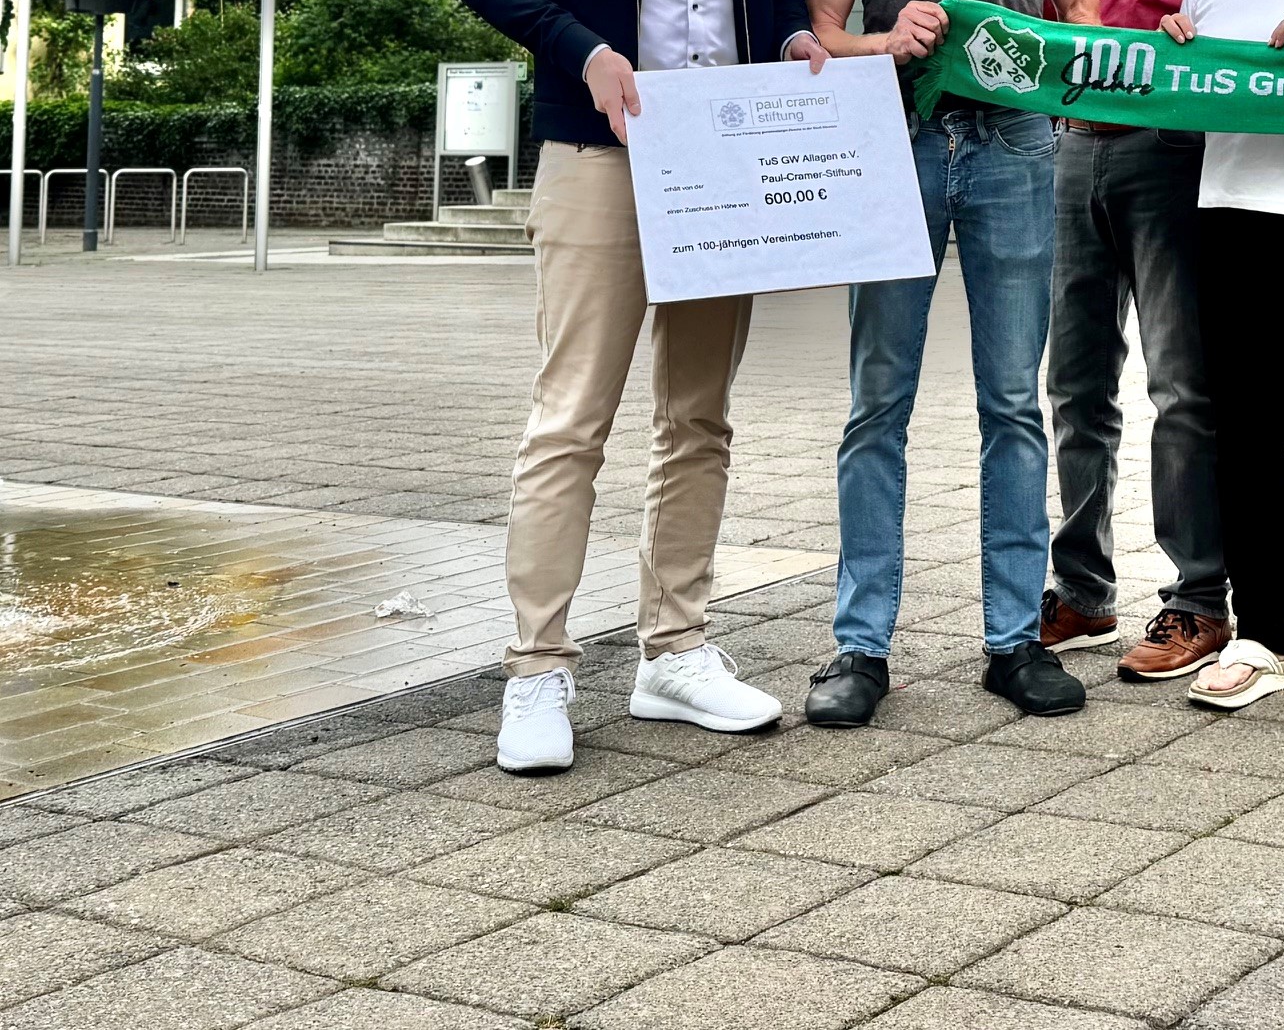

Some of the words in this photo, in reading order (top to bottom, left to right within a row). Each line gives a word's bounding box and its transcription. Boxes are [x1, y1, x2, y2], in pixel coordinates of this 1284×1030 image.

[982, 36, 997, 53] 19
[1007, 67, 1026, 84] 26
[1002, 38, 1031, 67] TuS
[1072, 36, 1156, 92] 100
[1165, 64, 1238, 94] TuS
[756, 98, 782, 112] paul
[786, 96, 830, 108] cramer
[758, 111, 804, 123] stiftung
[758, 157, 779, 166] TuS
[781, 154, 800, 164] GW
[802, 152, 838, 163] Allagen
[840, 150, 860, 160] e.V.
[761, 168, 862, 183] Paul-Cramer-Stiftung
[764, 189, 814, 205] 600,00
[818, 188, 828, 200] €
[672, 245, 694, 254] zum
[698, 237, 759, 251] 100-jährigen
[761, 230, 841, 244] Vereinbestehen.
